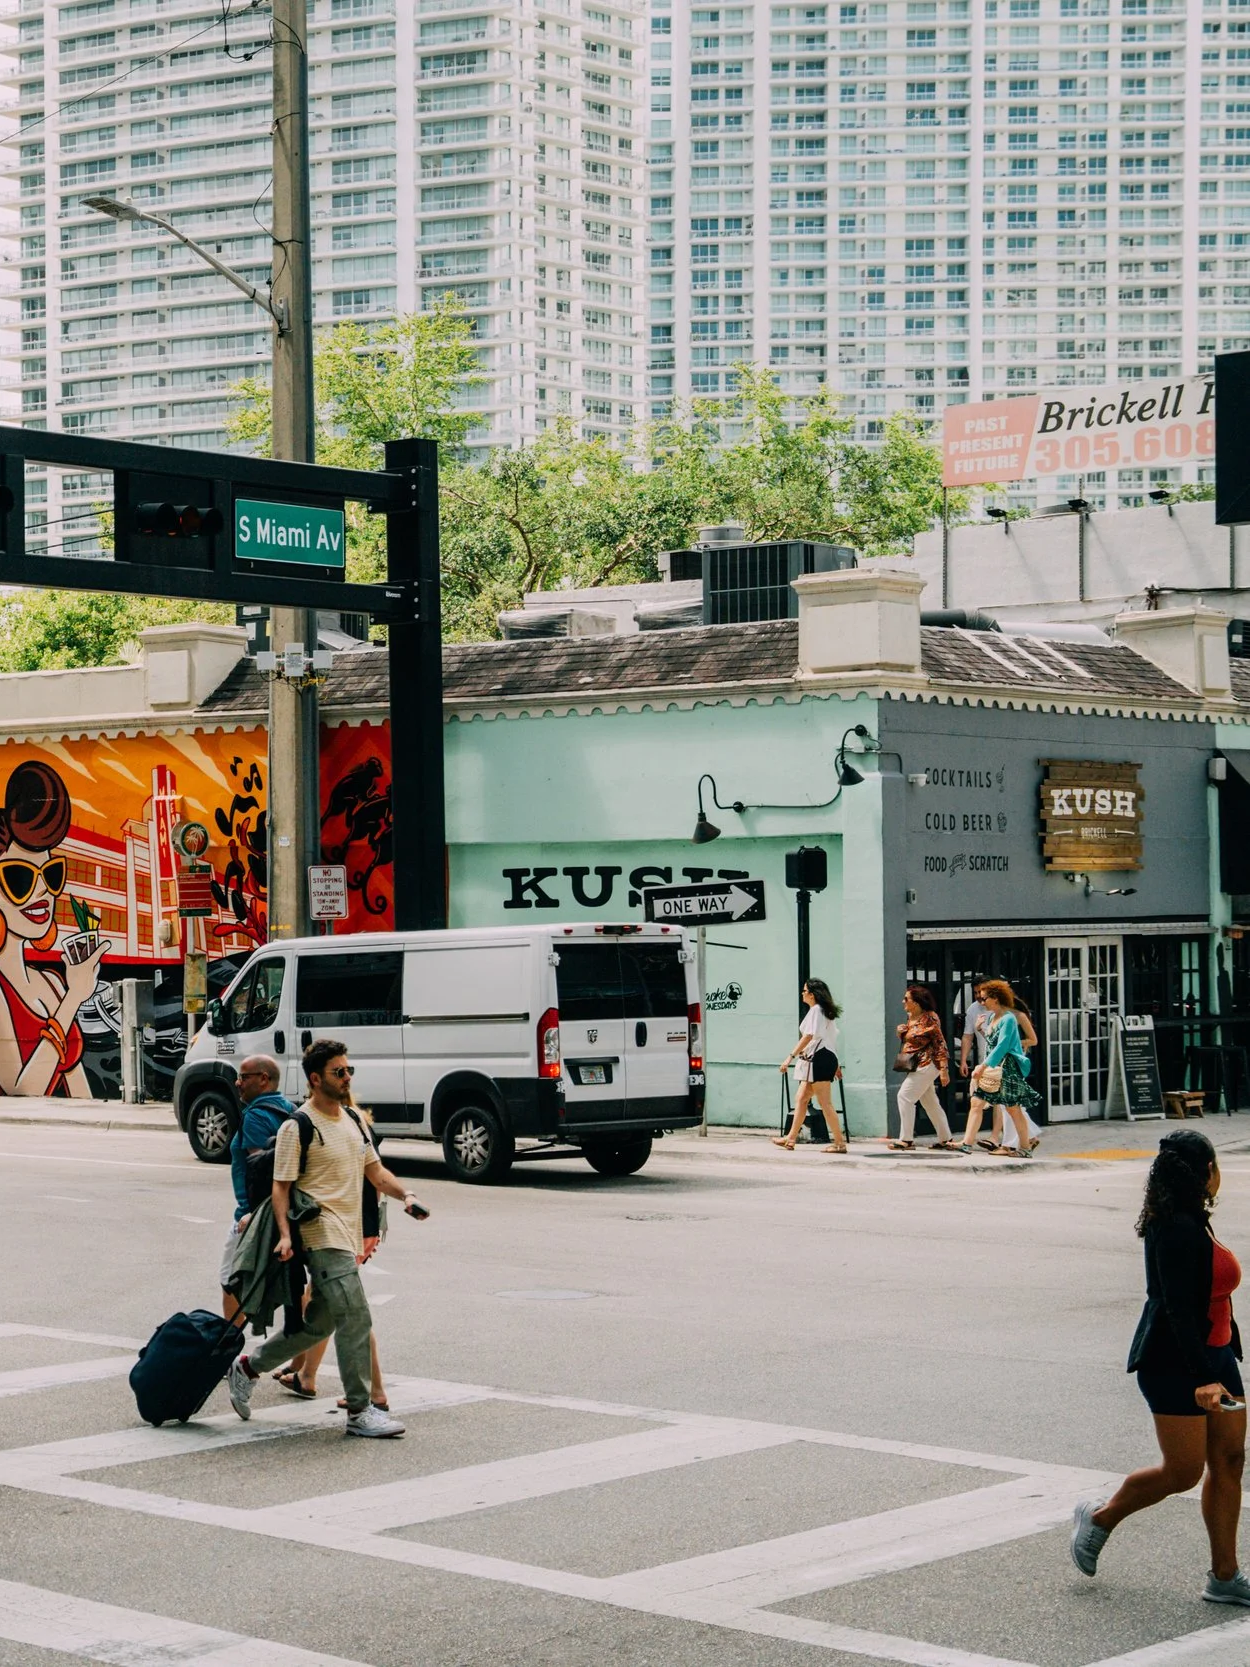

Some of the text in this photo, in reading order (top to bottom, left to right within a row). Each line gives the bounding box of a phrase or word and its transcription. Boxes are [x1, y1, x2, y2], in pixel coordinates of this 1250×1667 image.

[1037, 384, 1185, 433] Brickell
[964, 416, 1009, 434] PAST
[949, 433, 1024, 455] PRESENT
[954, 453, 1019, 474] FUTURE
[239, 515, 341, 551] S Miami Av
[924, 767, 992, 789] COCKTAILS
[1050, 788, 1136, 818] KUSH
[925, 812, 992, 832] COLD BEER
[924, 855, 948, 872] FOOD
[969, 855, 1009, 872] SCRATCH
[502, 866, 750, 909] KUS
[662, 896, 729, 915] ONE WAY
